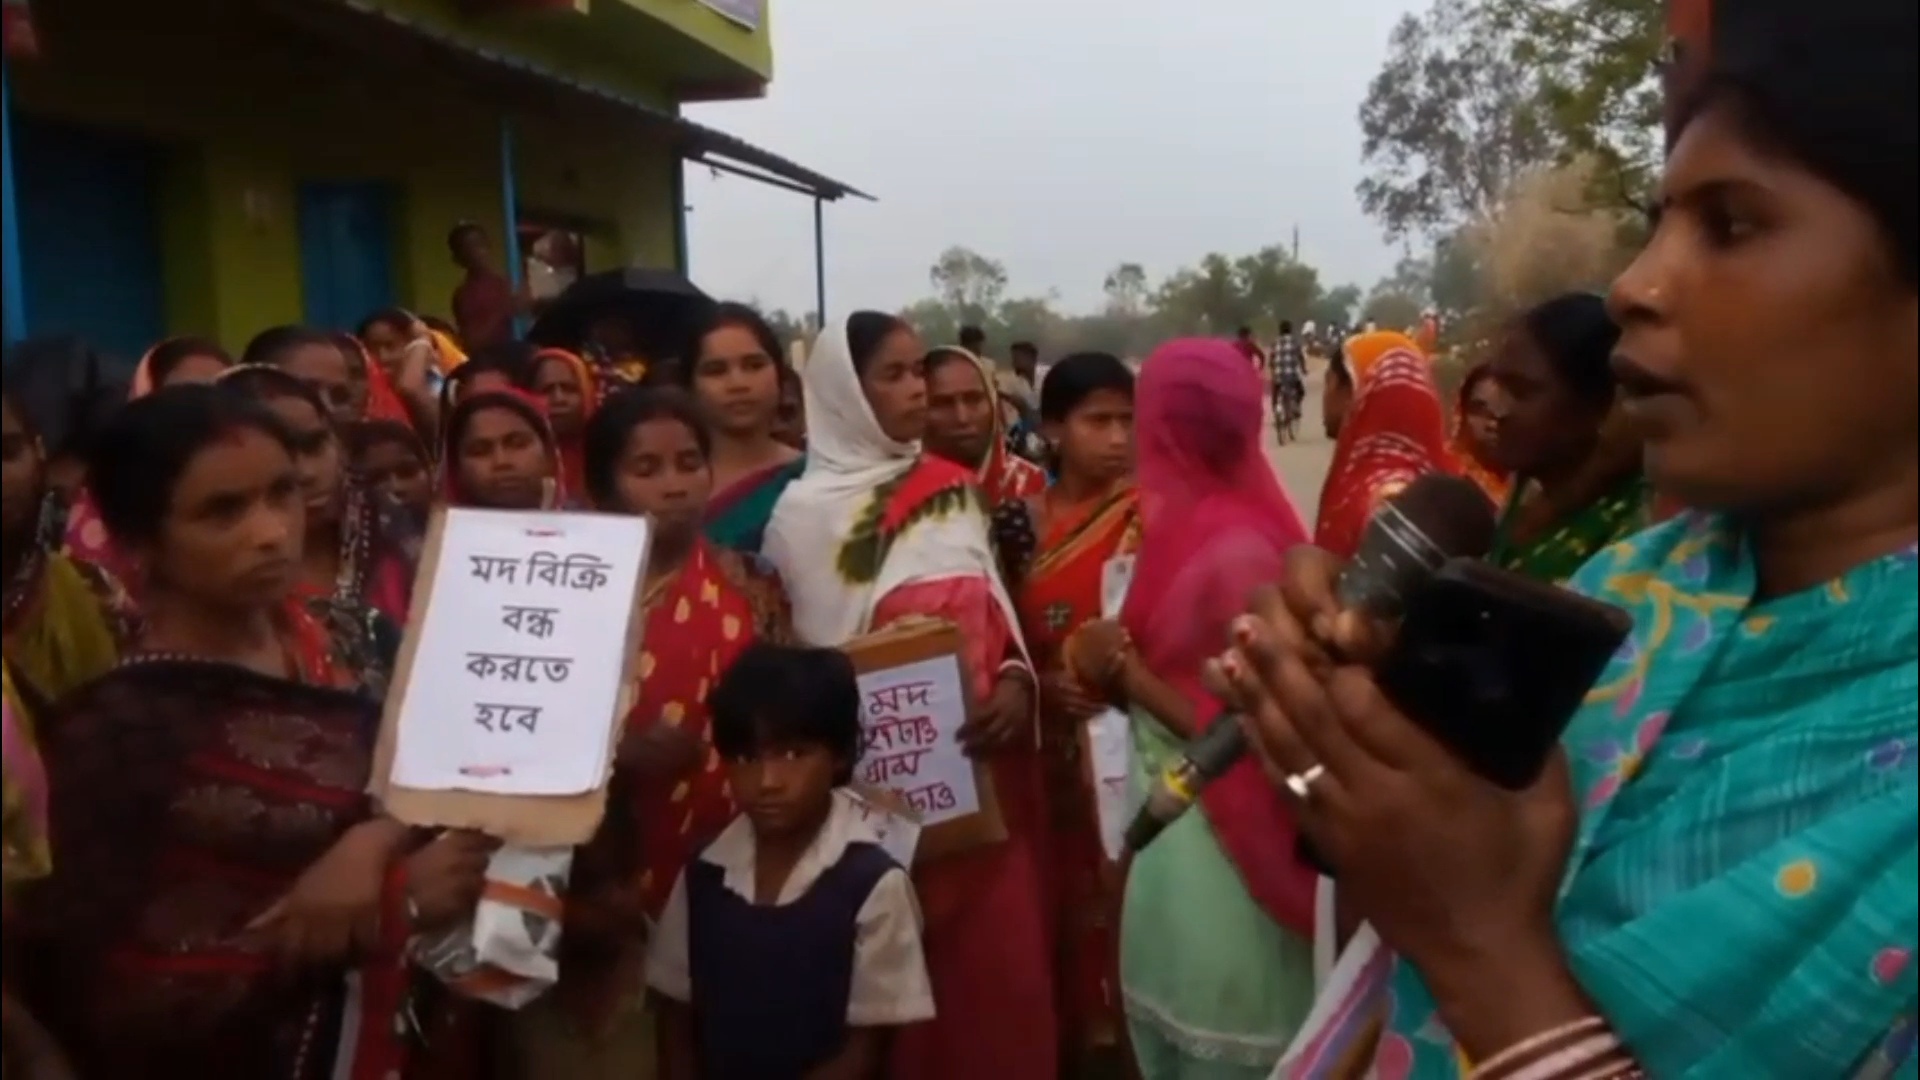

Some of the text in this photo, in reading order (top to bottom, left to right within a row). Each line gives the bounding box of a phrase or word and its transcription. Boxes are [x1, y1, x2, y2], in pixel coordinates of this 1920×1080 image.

[468, 551, 613, 591] মদ বিক্রি
[501, 605, 560, 639] বন্ধ
[465, 652, 574, 683] করতে
[868, 680, 935, 715] মদ
[474, 702, 543, 734] হবে
